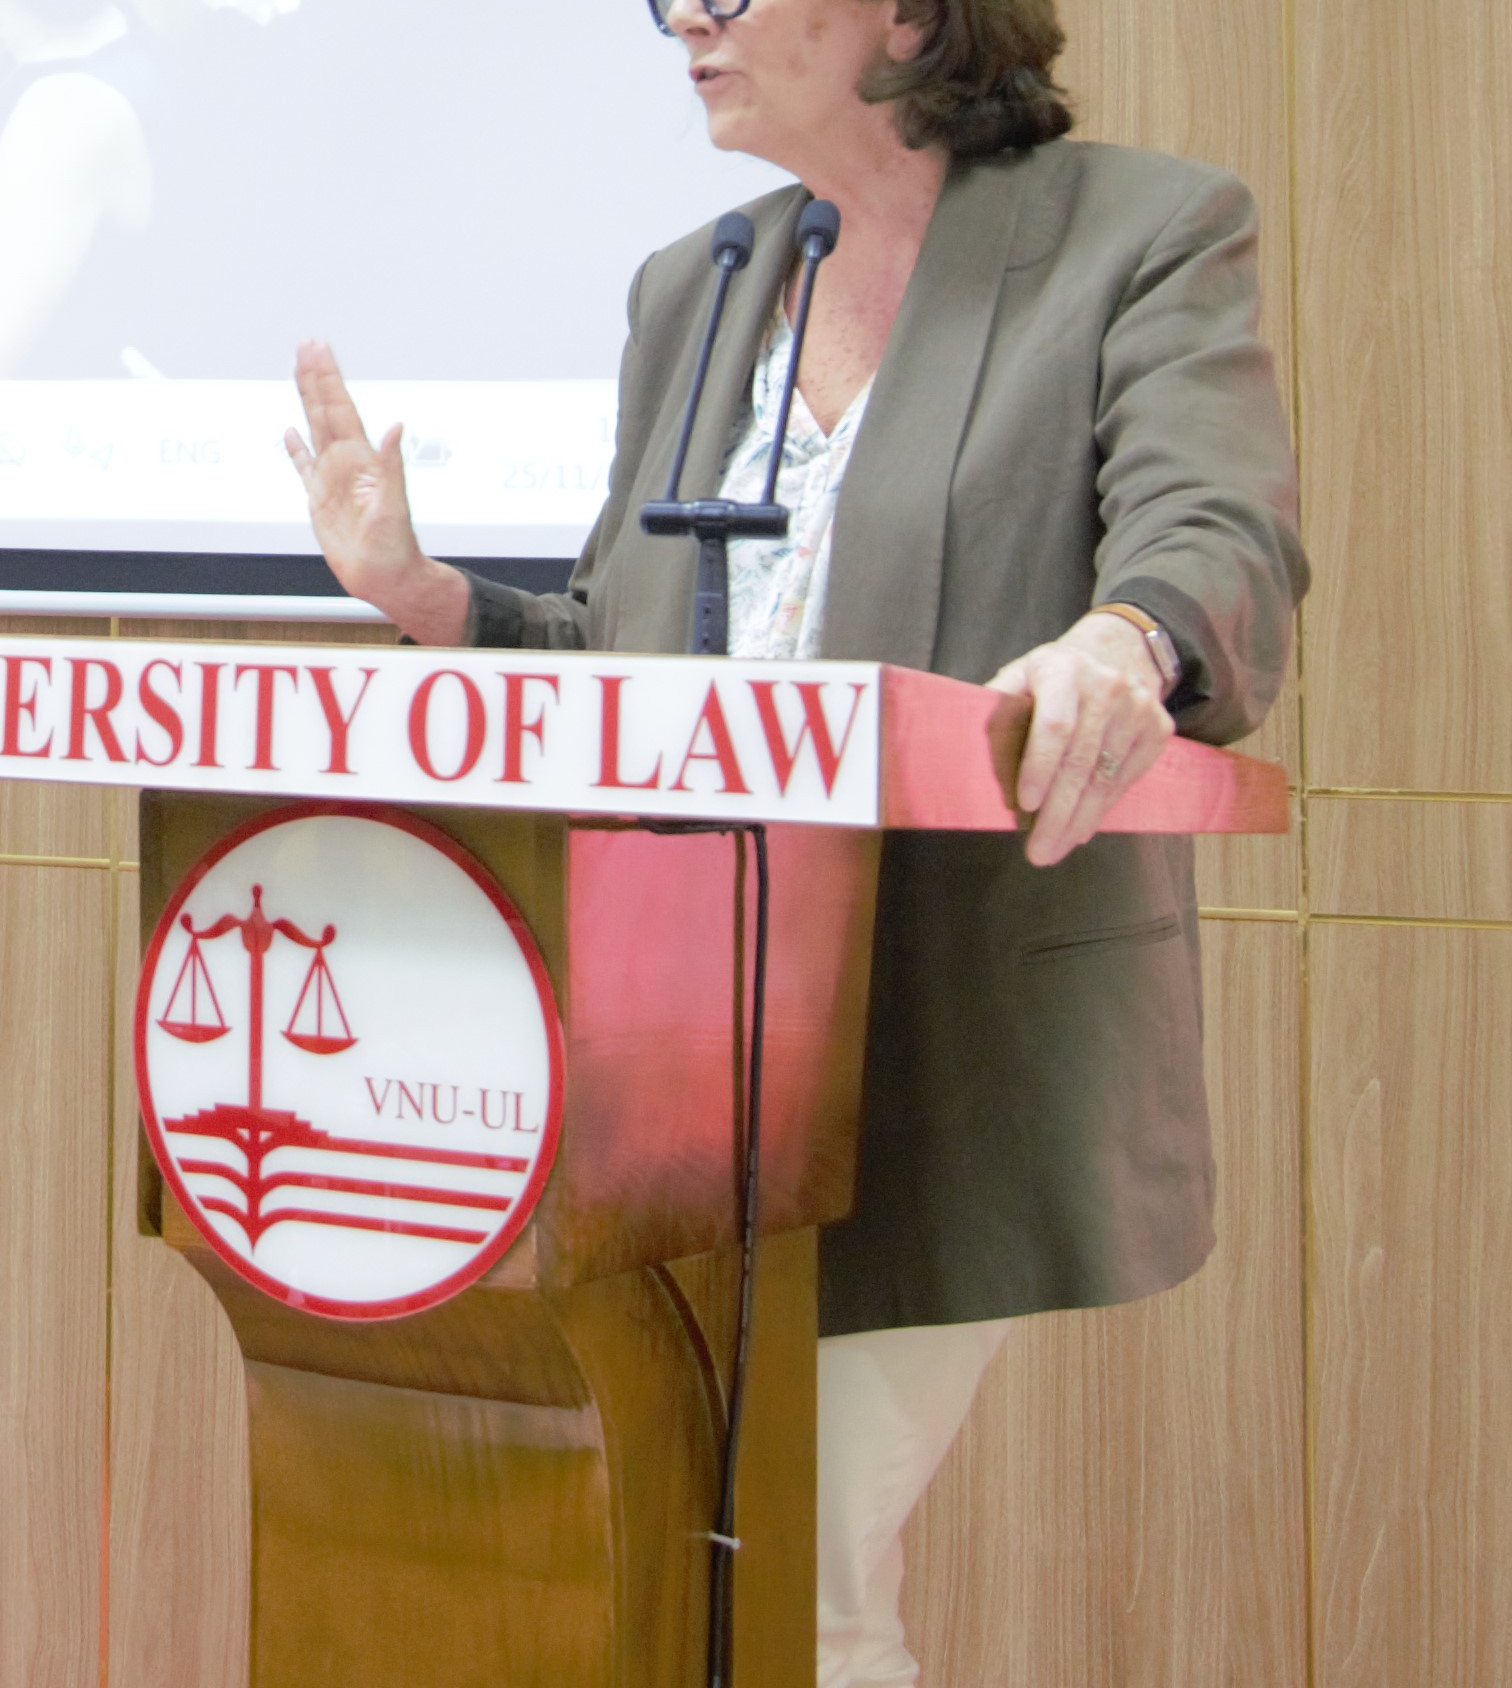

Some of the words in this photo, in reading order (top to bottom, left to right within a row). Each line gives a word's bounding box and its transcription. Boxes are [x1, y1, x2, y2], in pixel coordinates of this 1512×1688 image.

[503, 461, 608, 490] 25/11/
[406, 670, 561, 784] OF
[592, 674, 868, 800] LAW
[364, 1076, 540, 1133] VNU-UL
